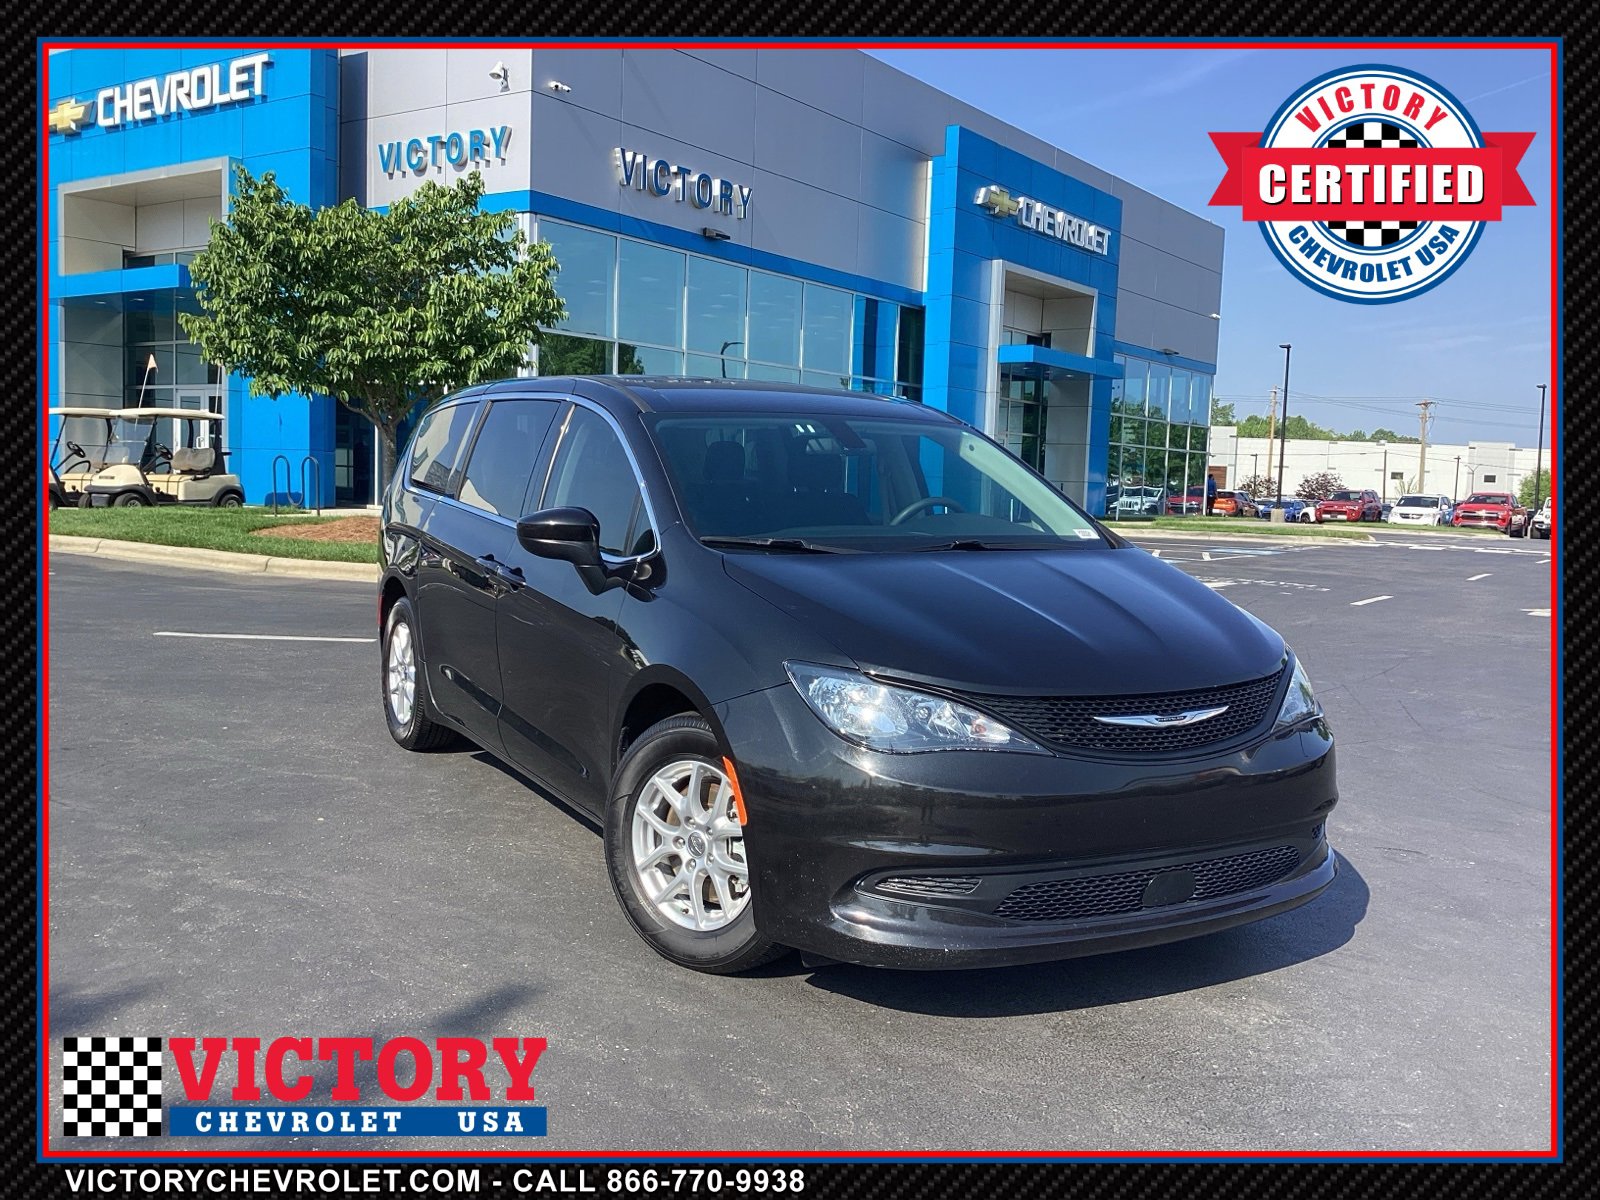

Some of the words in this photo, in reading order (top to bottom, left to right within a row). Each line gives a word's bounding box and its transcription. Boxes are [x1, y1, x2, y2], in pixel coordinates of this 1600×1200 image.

[97, 53, 269, 126] CHEVROLET
[378, 126, 511, 173] VICTORY
[615, 148, 752, 219] VICTORY
[1018, 197, 1112, 256] CHEVROLET
